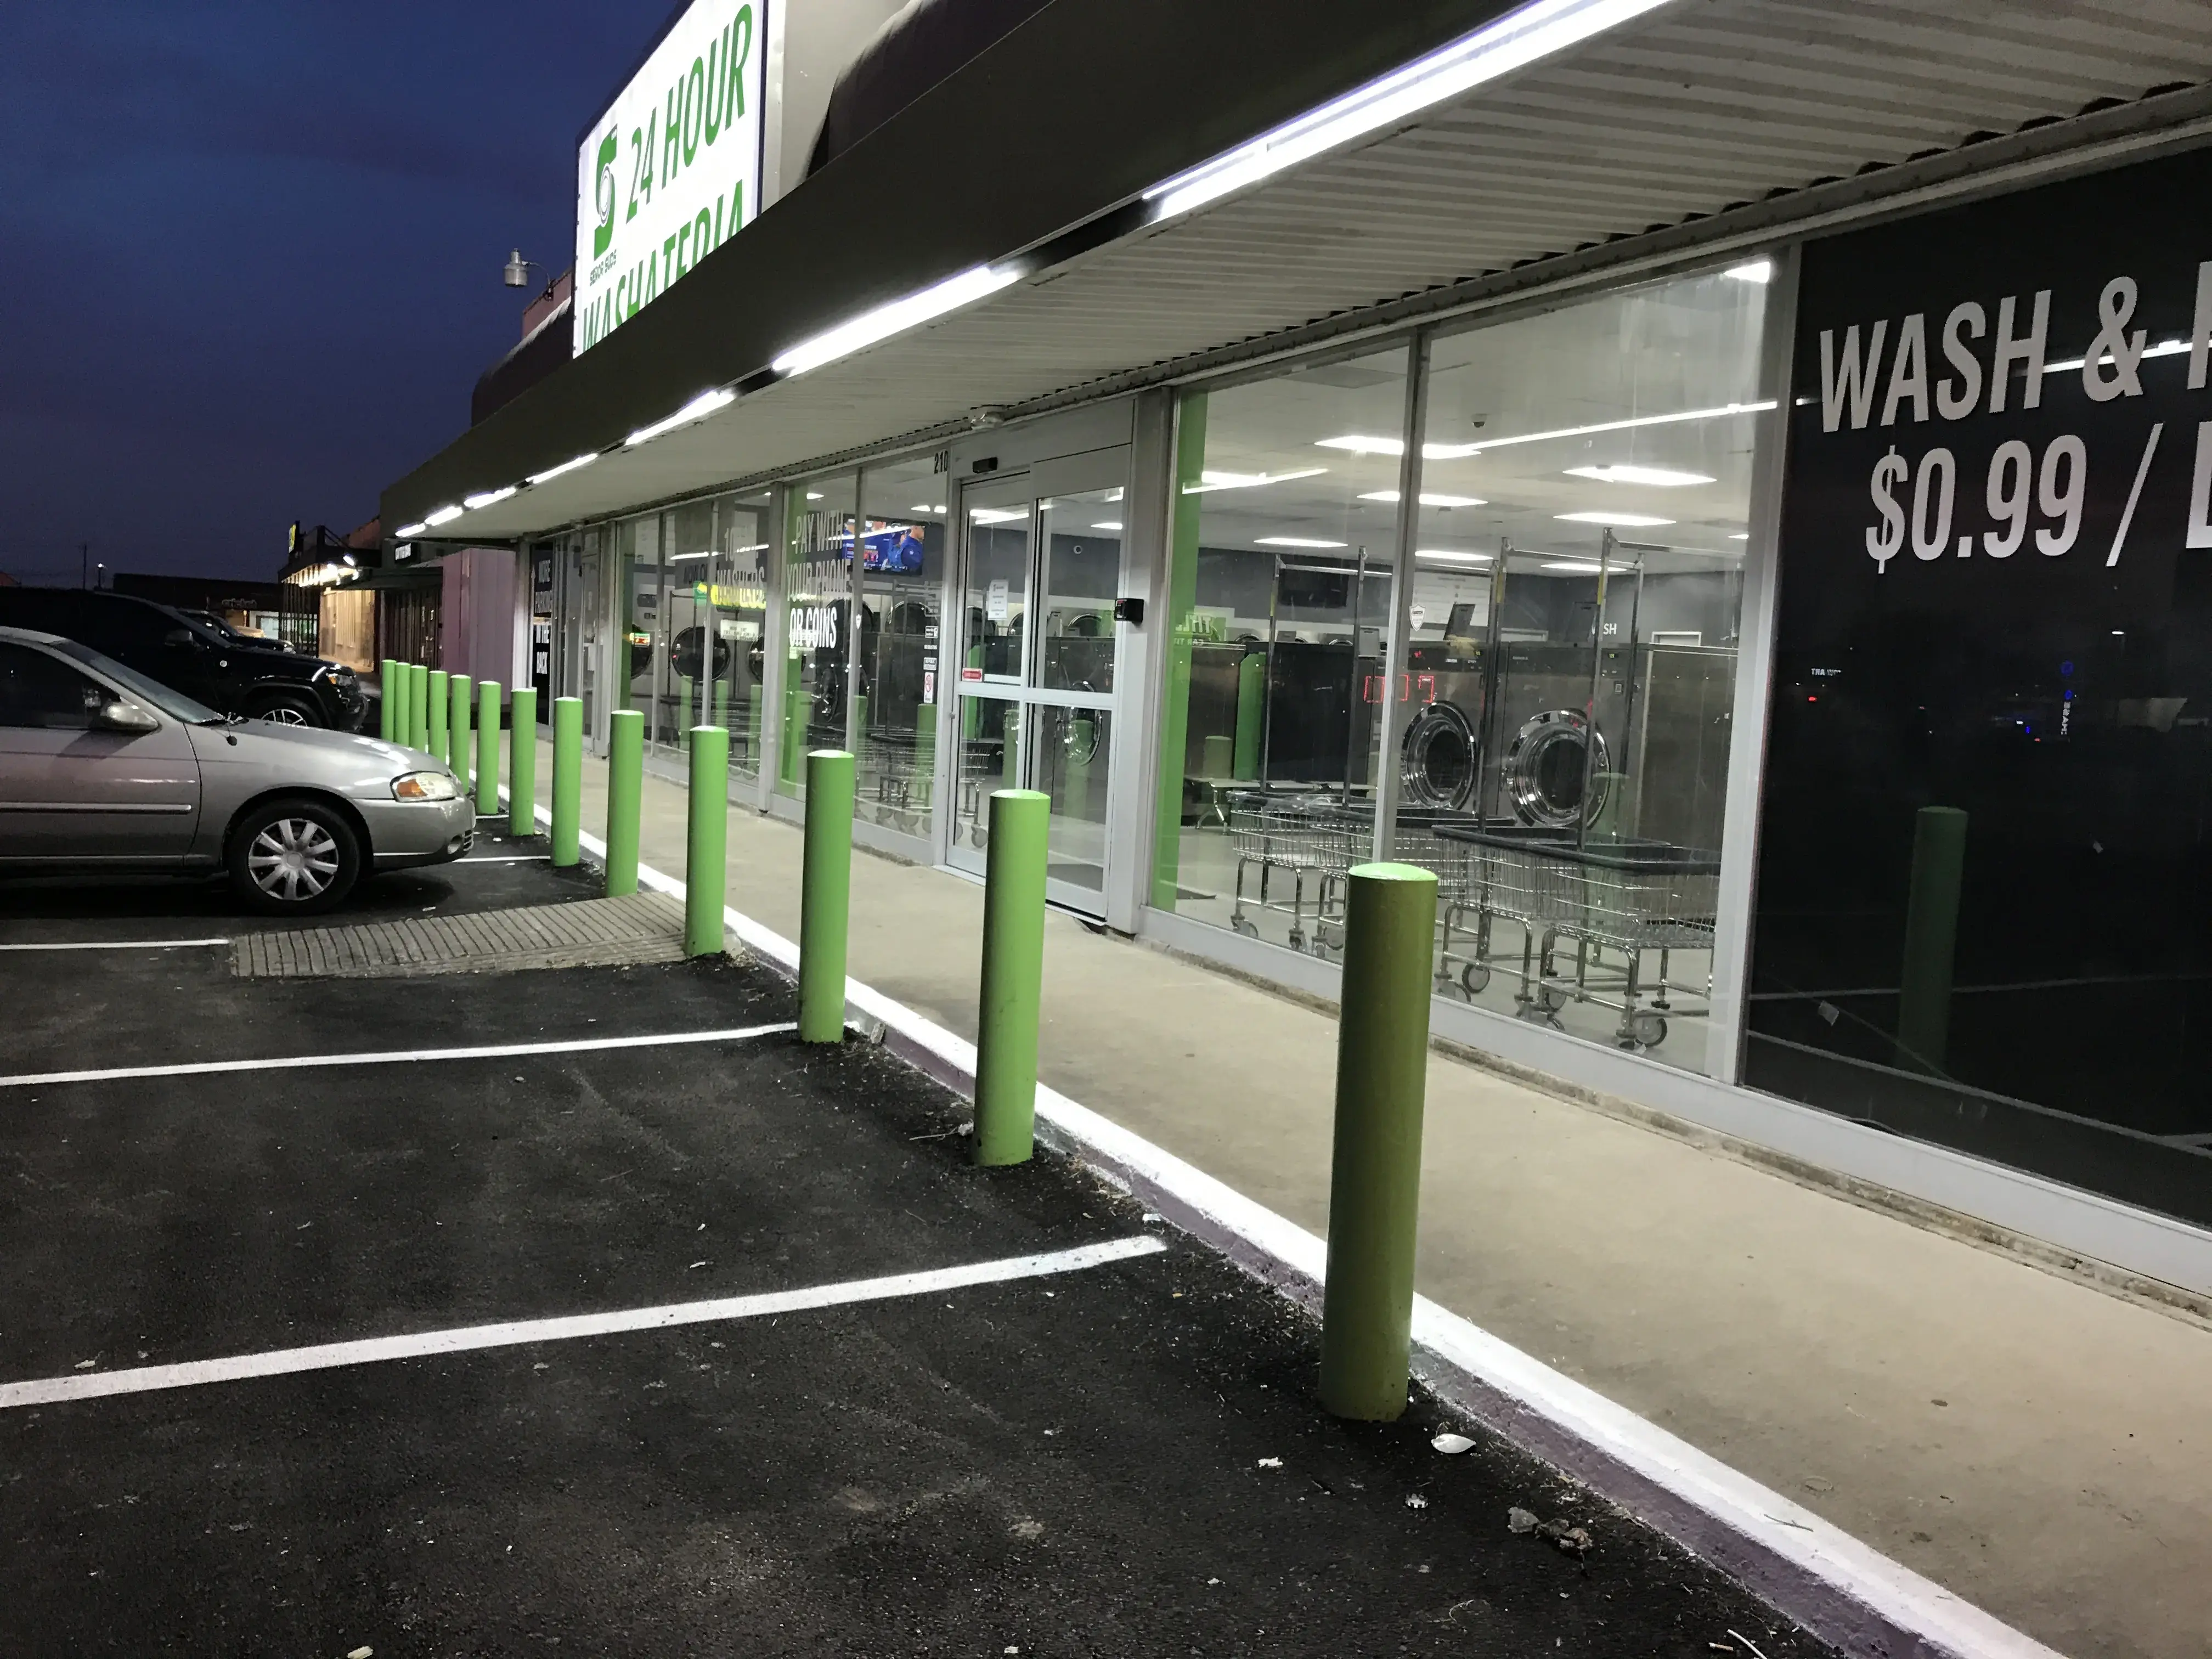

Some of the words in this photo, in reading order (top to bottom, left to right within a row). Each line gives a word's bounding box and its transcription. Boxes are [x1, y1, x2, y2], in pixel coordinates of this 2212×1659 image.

[627, 106, 657, 224] 24
[662, 4, 752, 190] HOUR
[1820, 290, 2051, 433] WASH
[2083, 276, 2148, 402] &
[934, 450, 948, 474] 210
[1866, 435, 2087, 574] $0.99
[795, 513, 814, 554] PAY
[817, 509, 843, 552] WITH
[787, 562, 812, 602] YOUR
[815, 558, 851, 601] PHONE
[789, 607, 804, 648] OR
[805, 606, 837, 648] COINS
